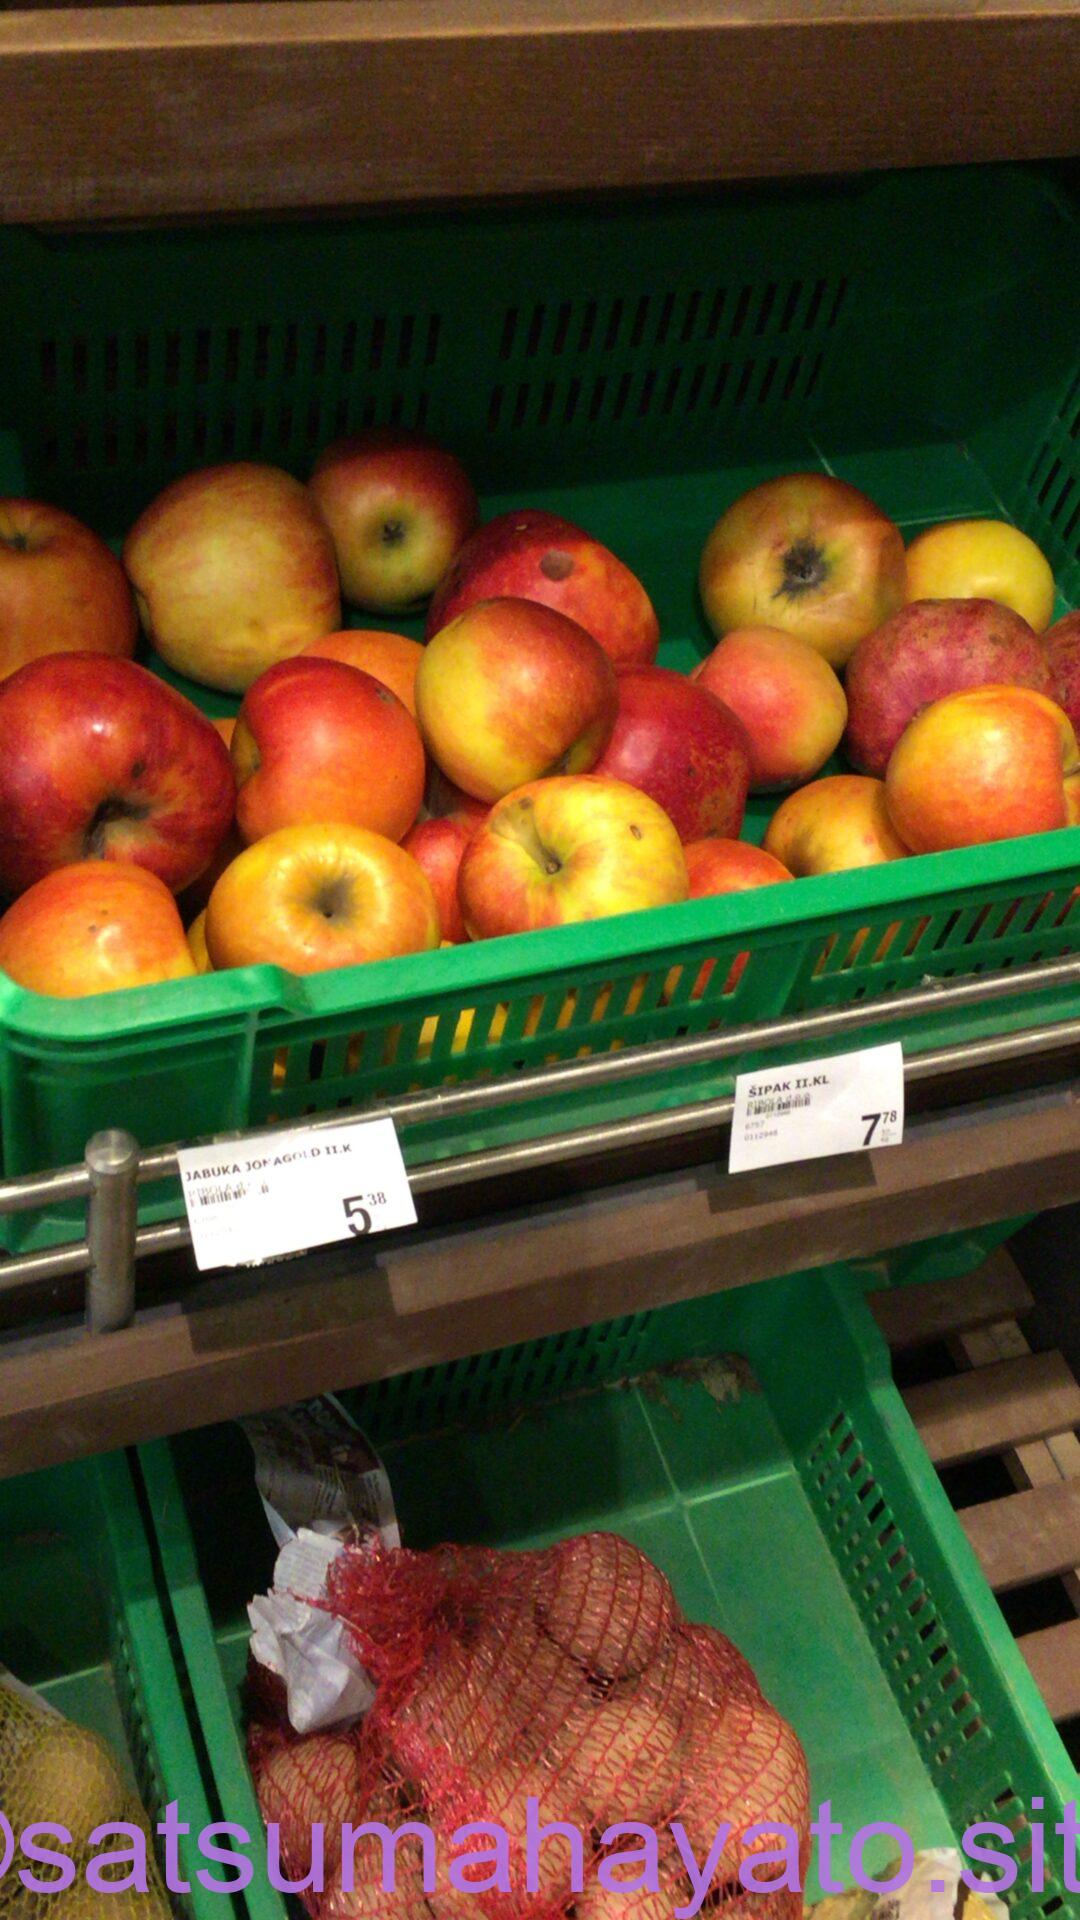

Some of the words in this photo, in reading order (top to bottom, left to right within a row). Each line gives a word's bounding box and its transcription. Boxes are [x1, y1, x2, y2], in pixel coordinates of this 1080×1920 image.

[748, 1081, 791, 1098] ŠIPAK
[795, 1075, 829, 1089] II.KL
[185, 1163, 241, 1182] JABUKA
